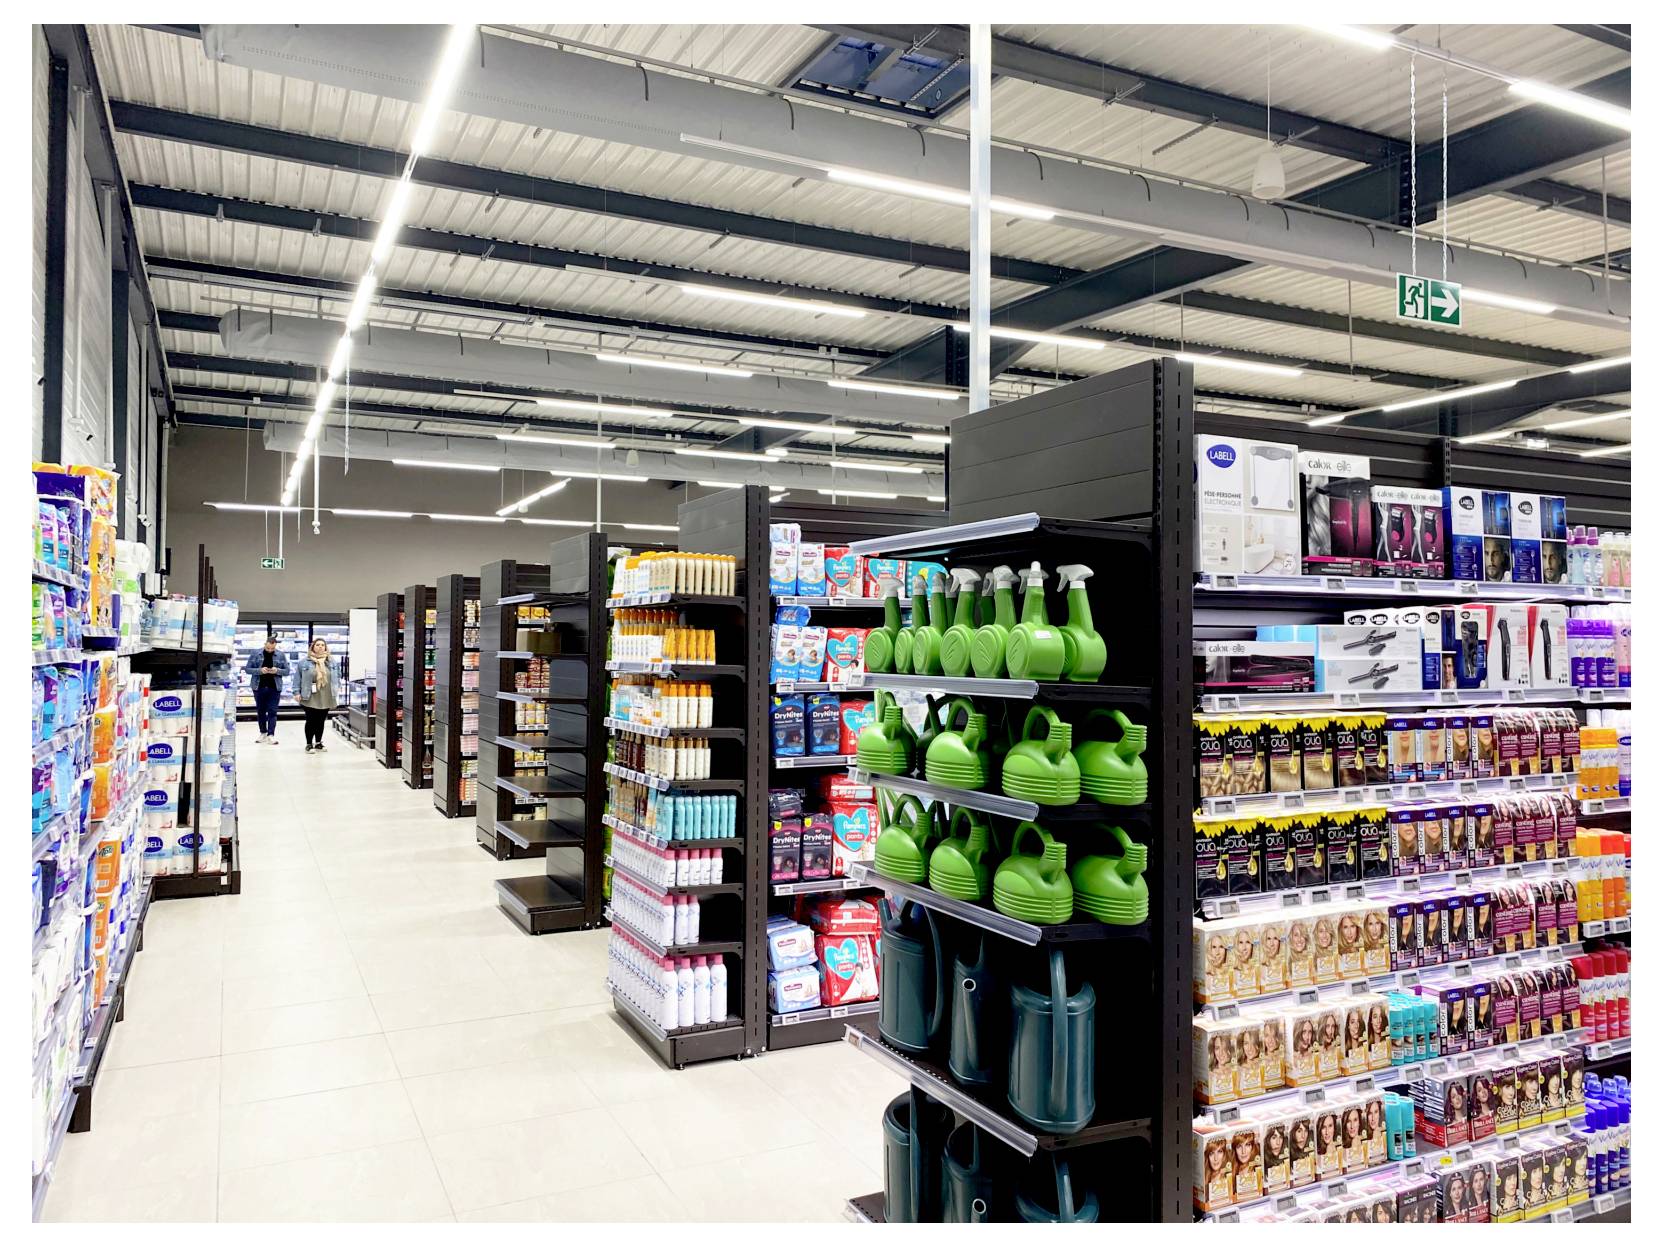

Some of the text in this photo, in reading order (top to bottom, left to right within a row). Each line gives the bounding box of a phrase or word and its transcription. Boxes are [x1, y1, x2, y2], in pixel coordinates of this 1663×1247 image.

[1210, 450, 1234, 461] LABELL
[774, 712, 803, 720] DryNites
[813, 710, 839, 718] DryNites
[804, 833, 831, 841] DryNites
